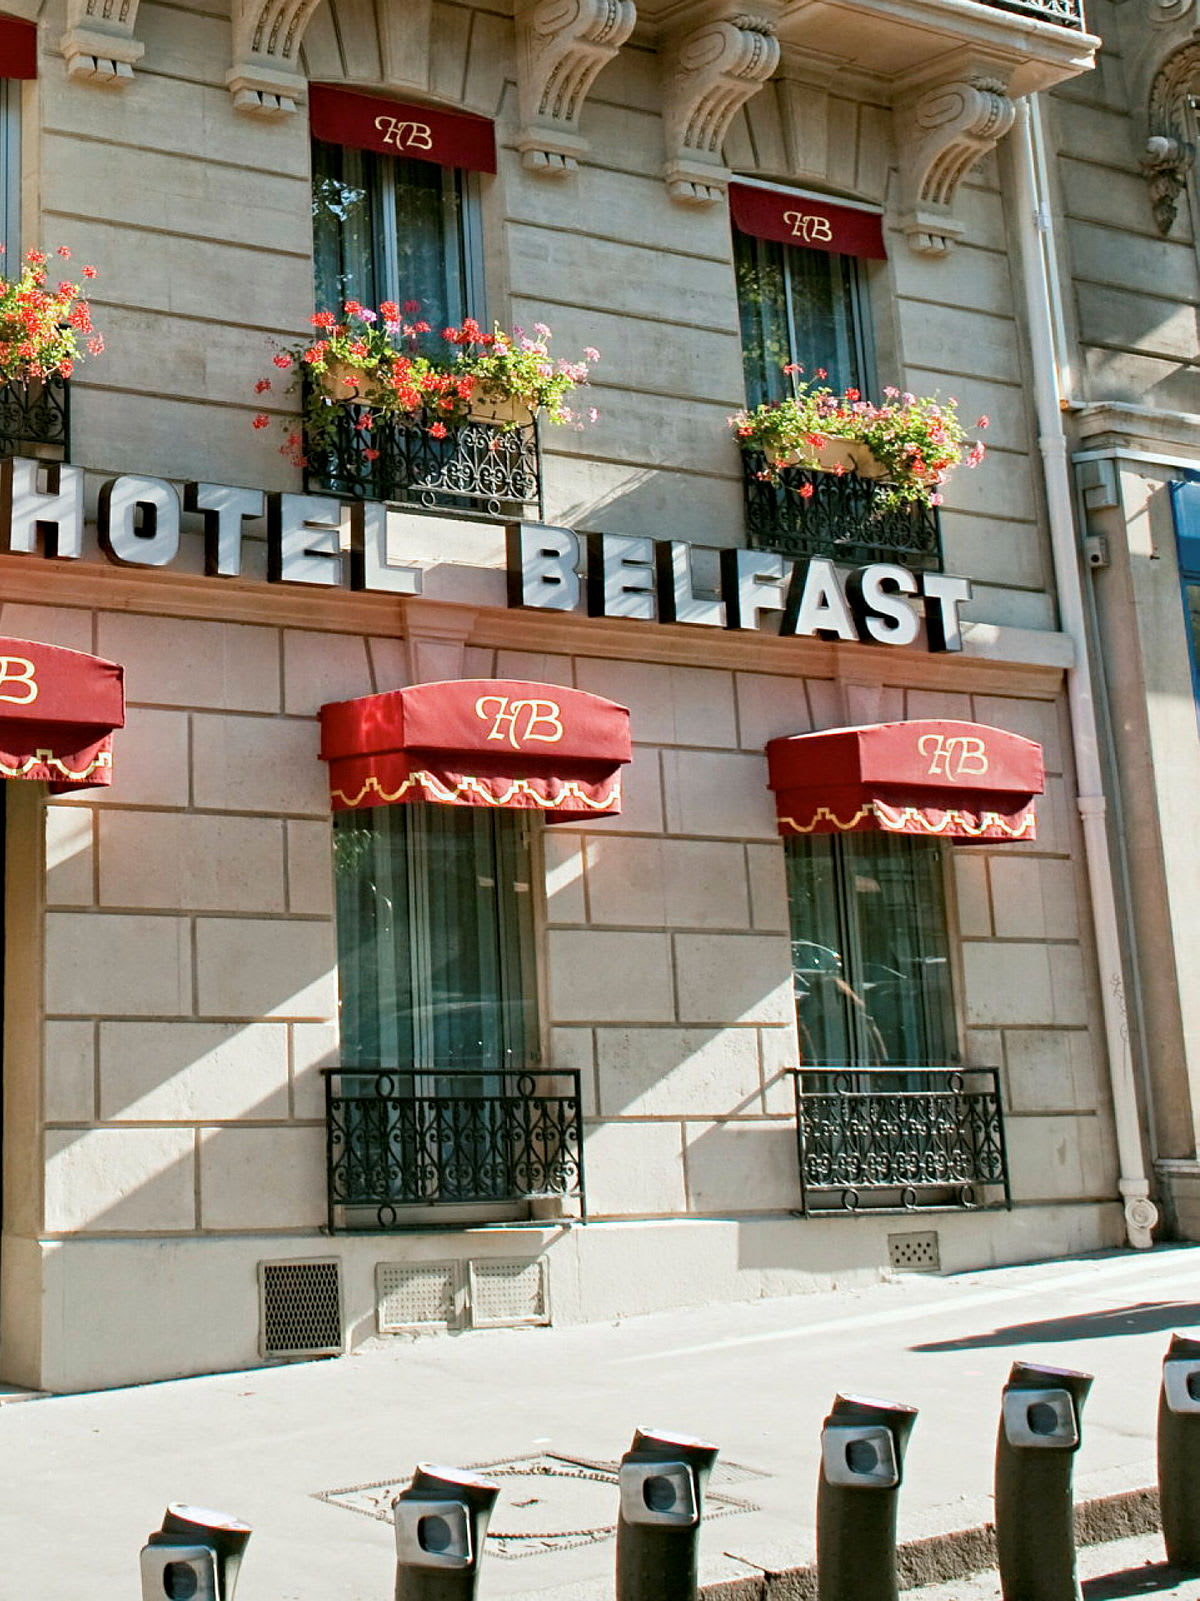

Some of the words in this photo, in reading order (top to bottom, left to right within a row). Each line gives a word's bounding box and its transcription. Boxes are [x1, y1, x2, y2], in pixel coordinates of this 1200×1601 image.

[375, 116, 433, 151] HB
[783, 211, 832, 242] HB
[1, 456, 423, 596] HOTEL
[506, 522, 972, 653] BELFAST
[475, 696, 563, 749] HB
[918, 735, 988, 782] HB
